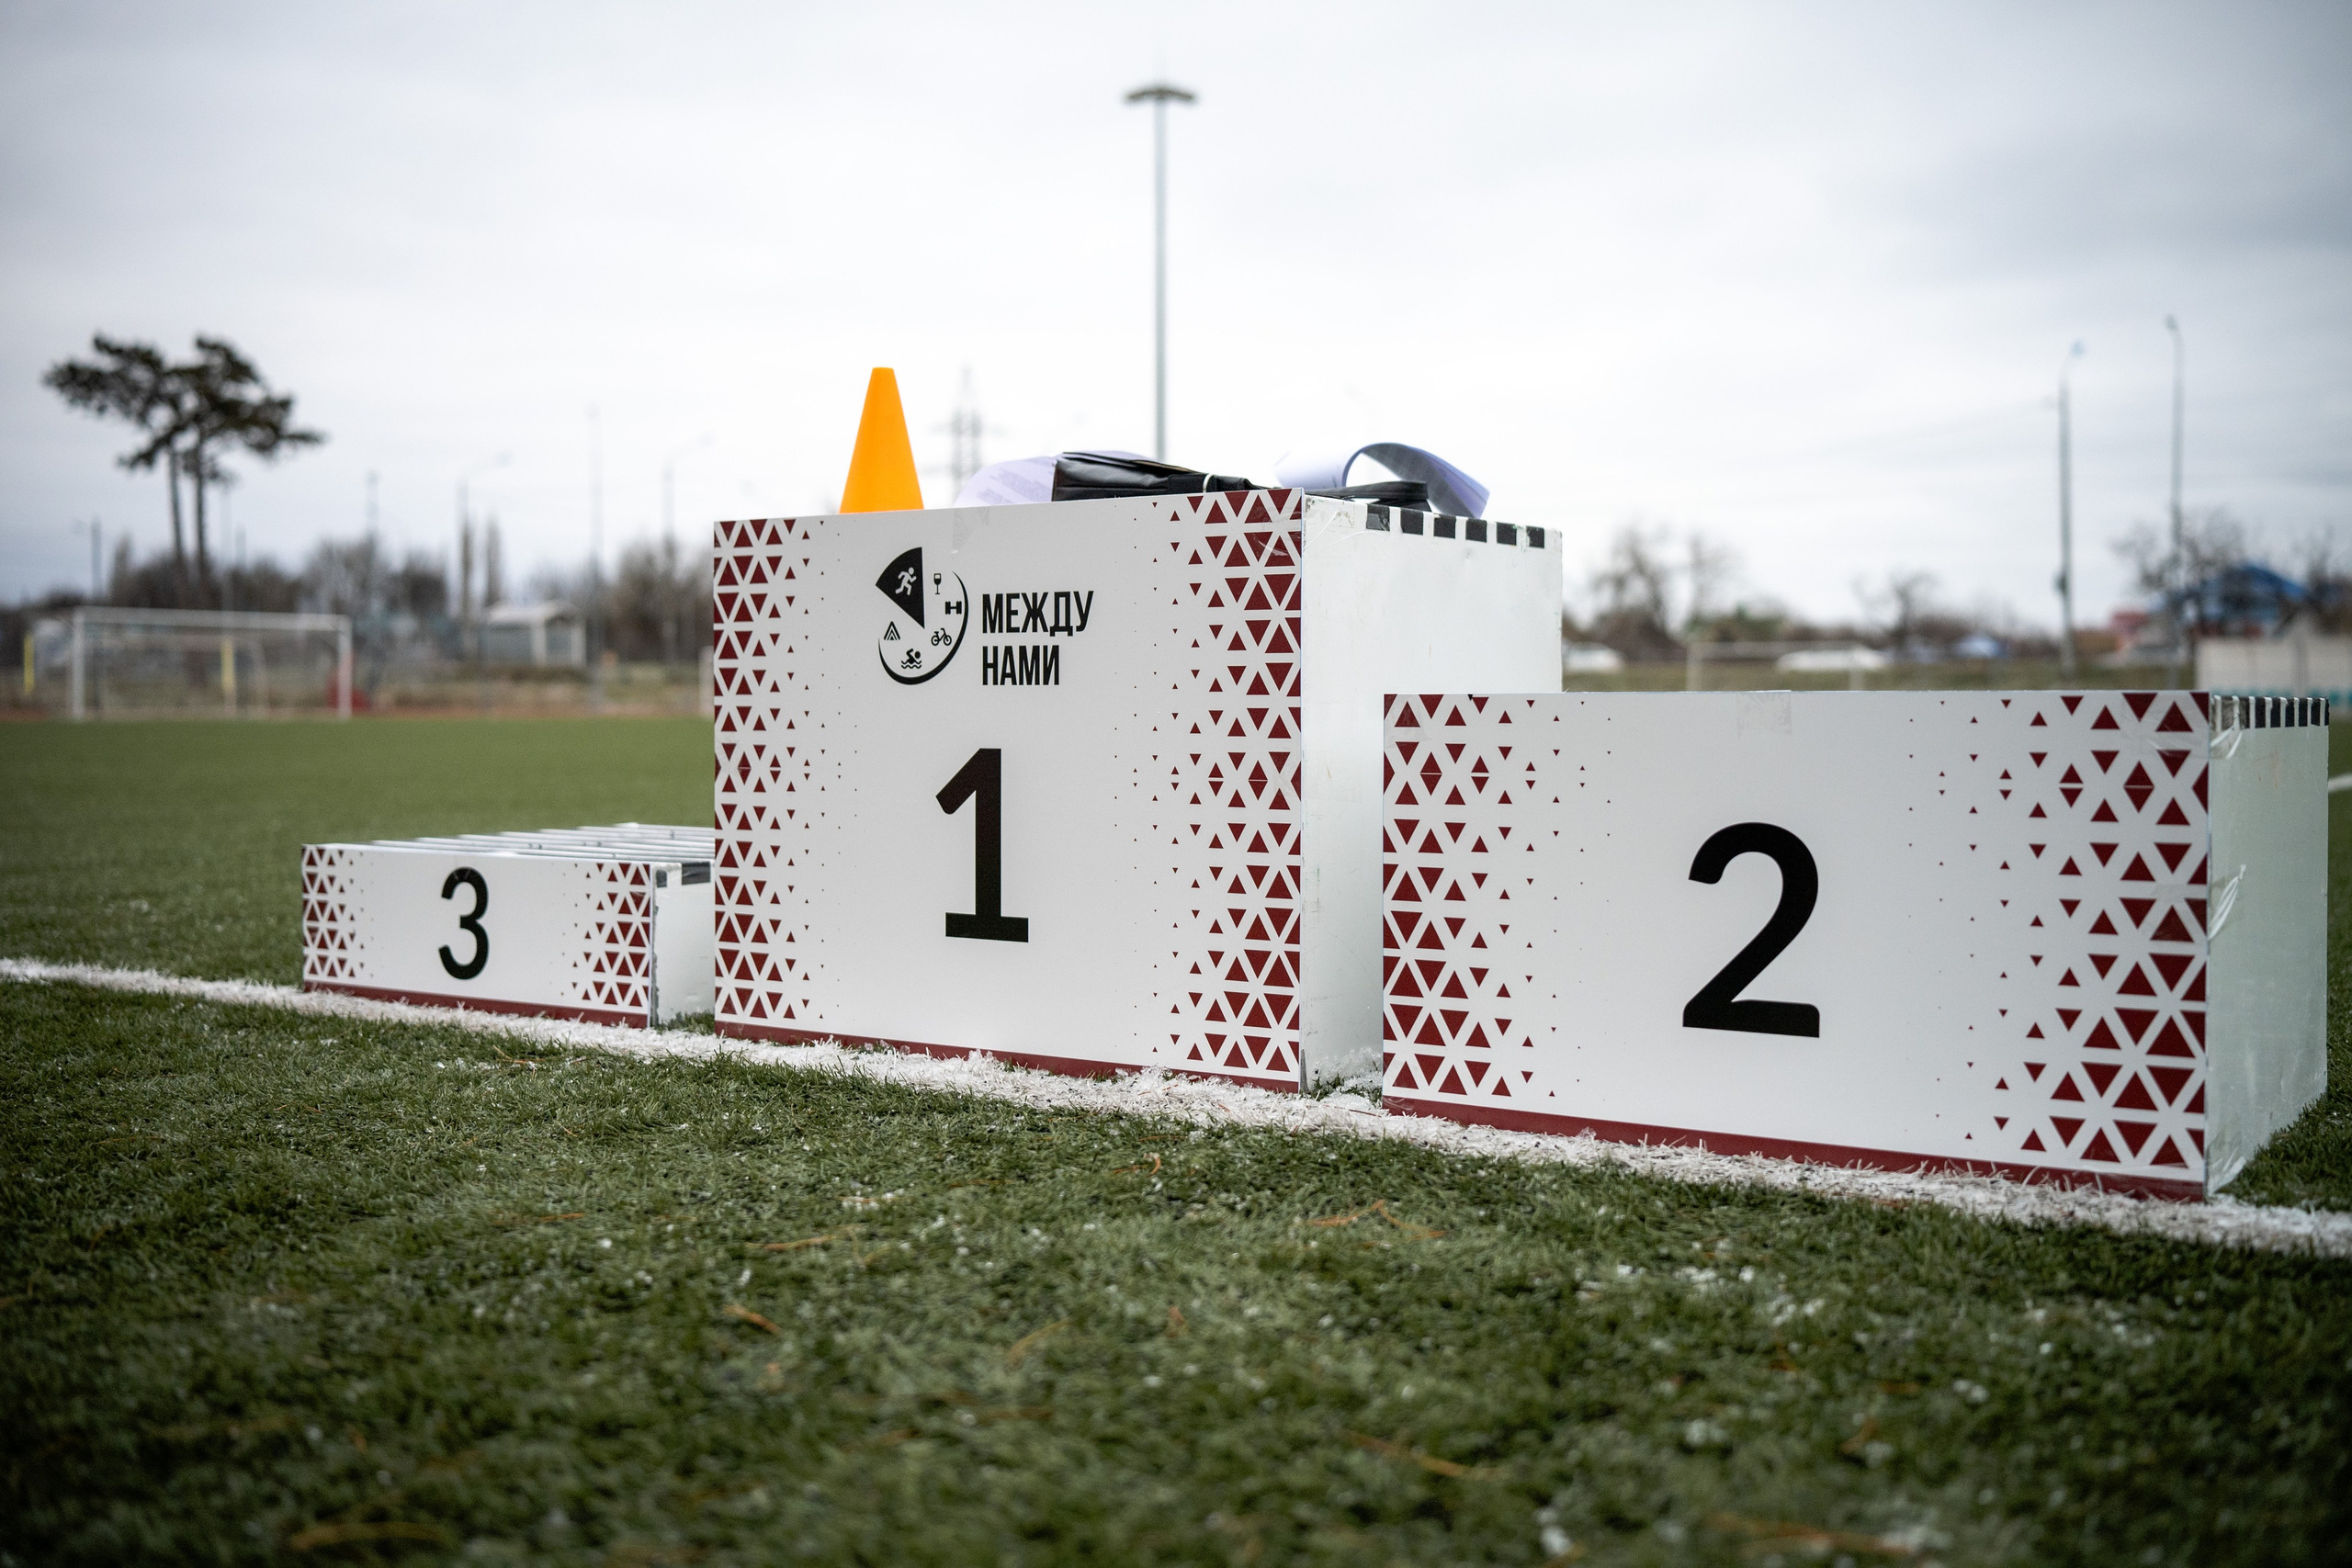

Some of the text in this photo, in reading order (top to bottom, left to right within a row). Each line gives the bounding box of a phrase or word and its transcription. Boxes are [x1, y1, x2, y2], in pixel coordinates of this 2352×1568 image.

[982, 590, 1095, 637] МЕЖДУ
[982, 644, 1060, 687] НАМИ
[935, 748, 1030, 944] 1
[438, 865, 490, 982] 3
[1682, 821, 1821, 1039] 2
